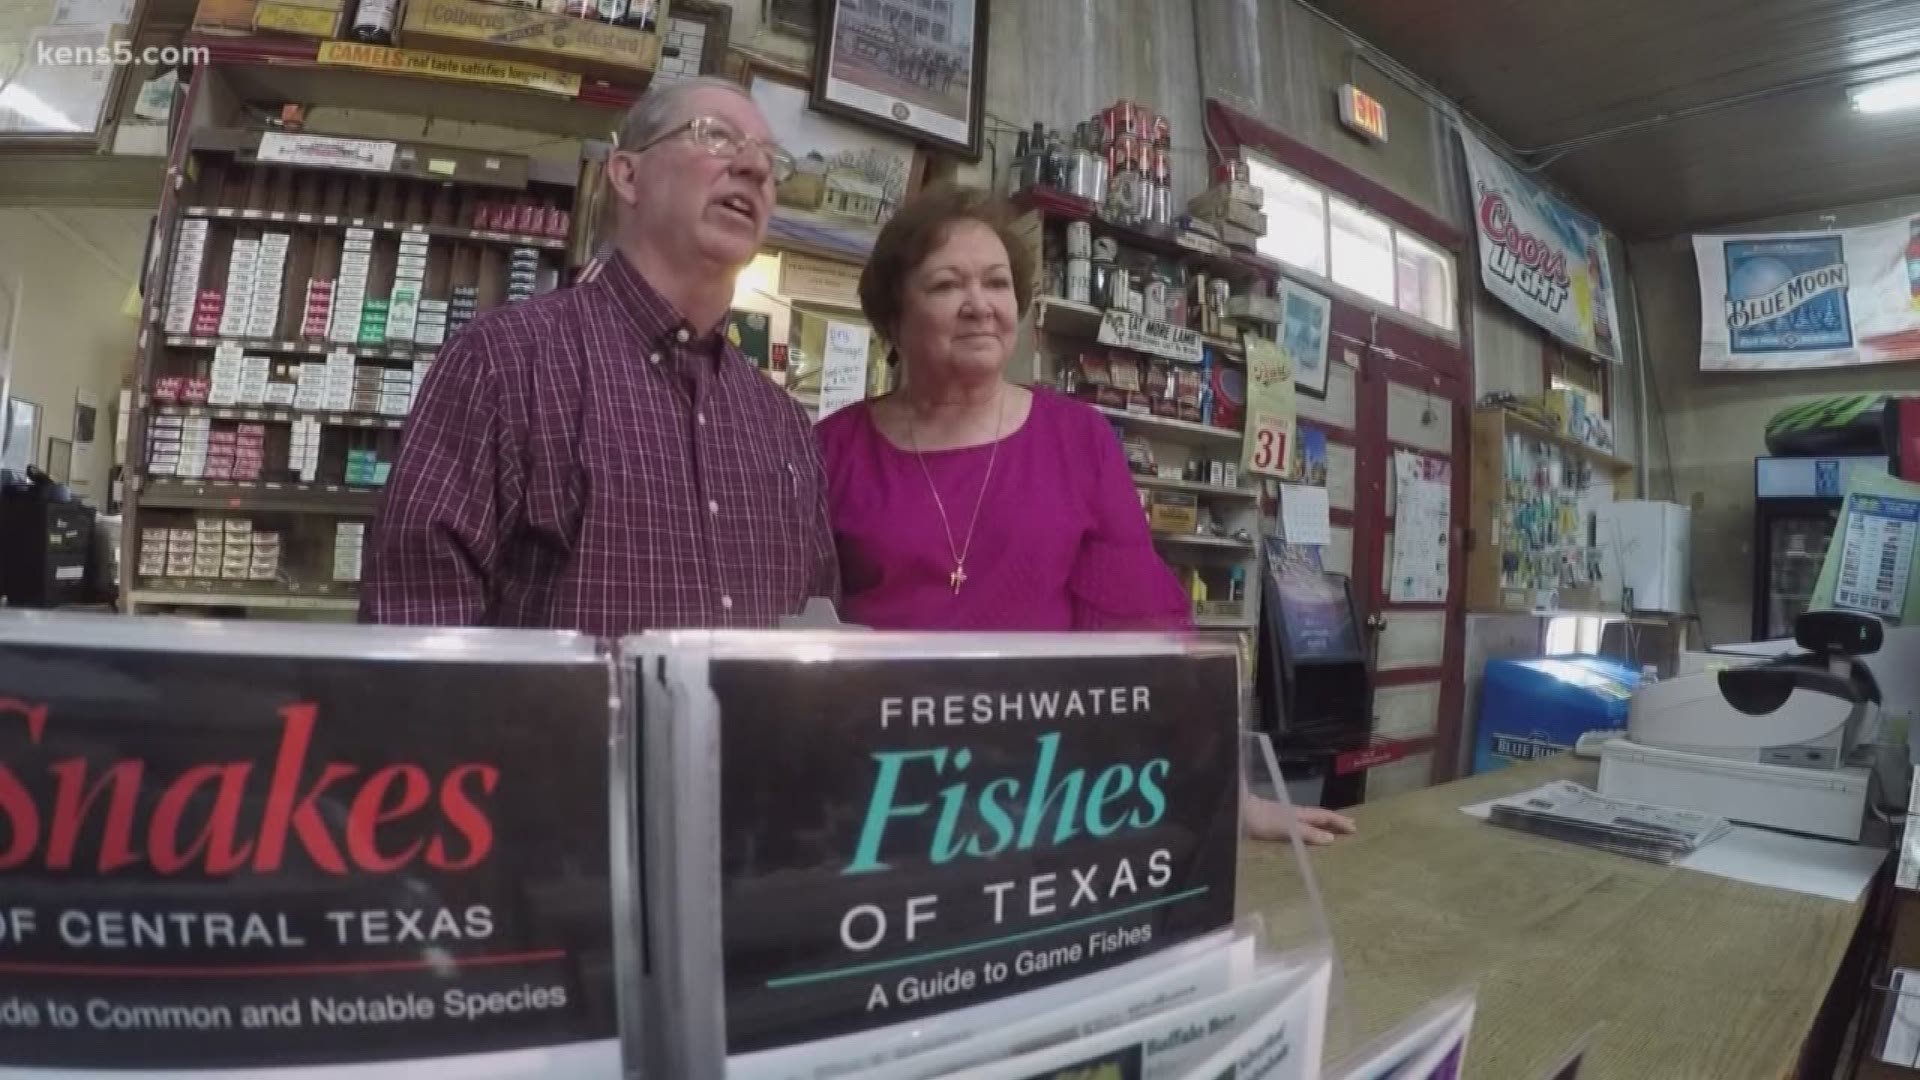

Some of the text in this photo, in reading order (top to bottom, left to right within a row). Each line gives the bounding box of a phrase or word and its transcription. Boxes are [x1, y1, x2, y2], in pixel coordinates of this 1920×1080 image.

[330, 43, 404, 70] CAMELS
[407, 55, 430, 69] real
[431, 59, 459, 73] taste
[461, 62, 505, 79] satisfies
[1355, 92, 1382, 133] EXIT
[1477, 182, 1570, 288] Coors
[1489, 245, 1568, 313] LIGHT
[1728, 267, 1844, 329] BLUE MOON
[1146, 320, 1171, 338] MORE
[1254, 430, 1286, 470] 31
[880, 686, 1150, 729] FRESHWATER
[1497, 738, 1530, 757] BLUE
[841, 731, 1171, 877] Fishes
[840, 849, 1173, 952] OF TEXAS
[59, 911, 306, 948] CENTRAL
[327, 905, 495, 944] TEXAS
[866, 922, 1152, 1012] A Guide to Game Fishes
[47, 999, 79, 1029] to
[87, 998, 232, 1031] Common
[241, 997, 301, 1028] and
[311, 990, 435, 1027] Notable
[444, 984, 568, 1021] Species
